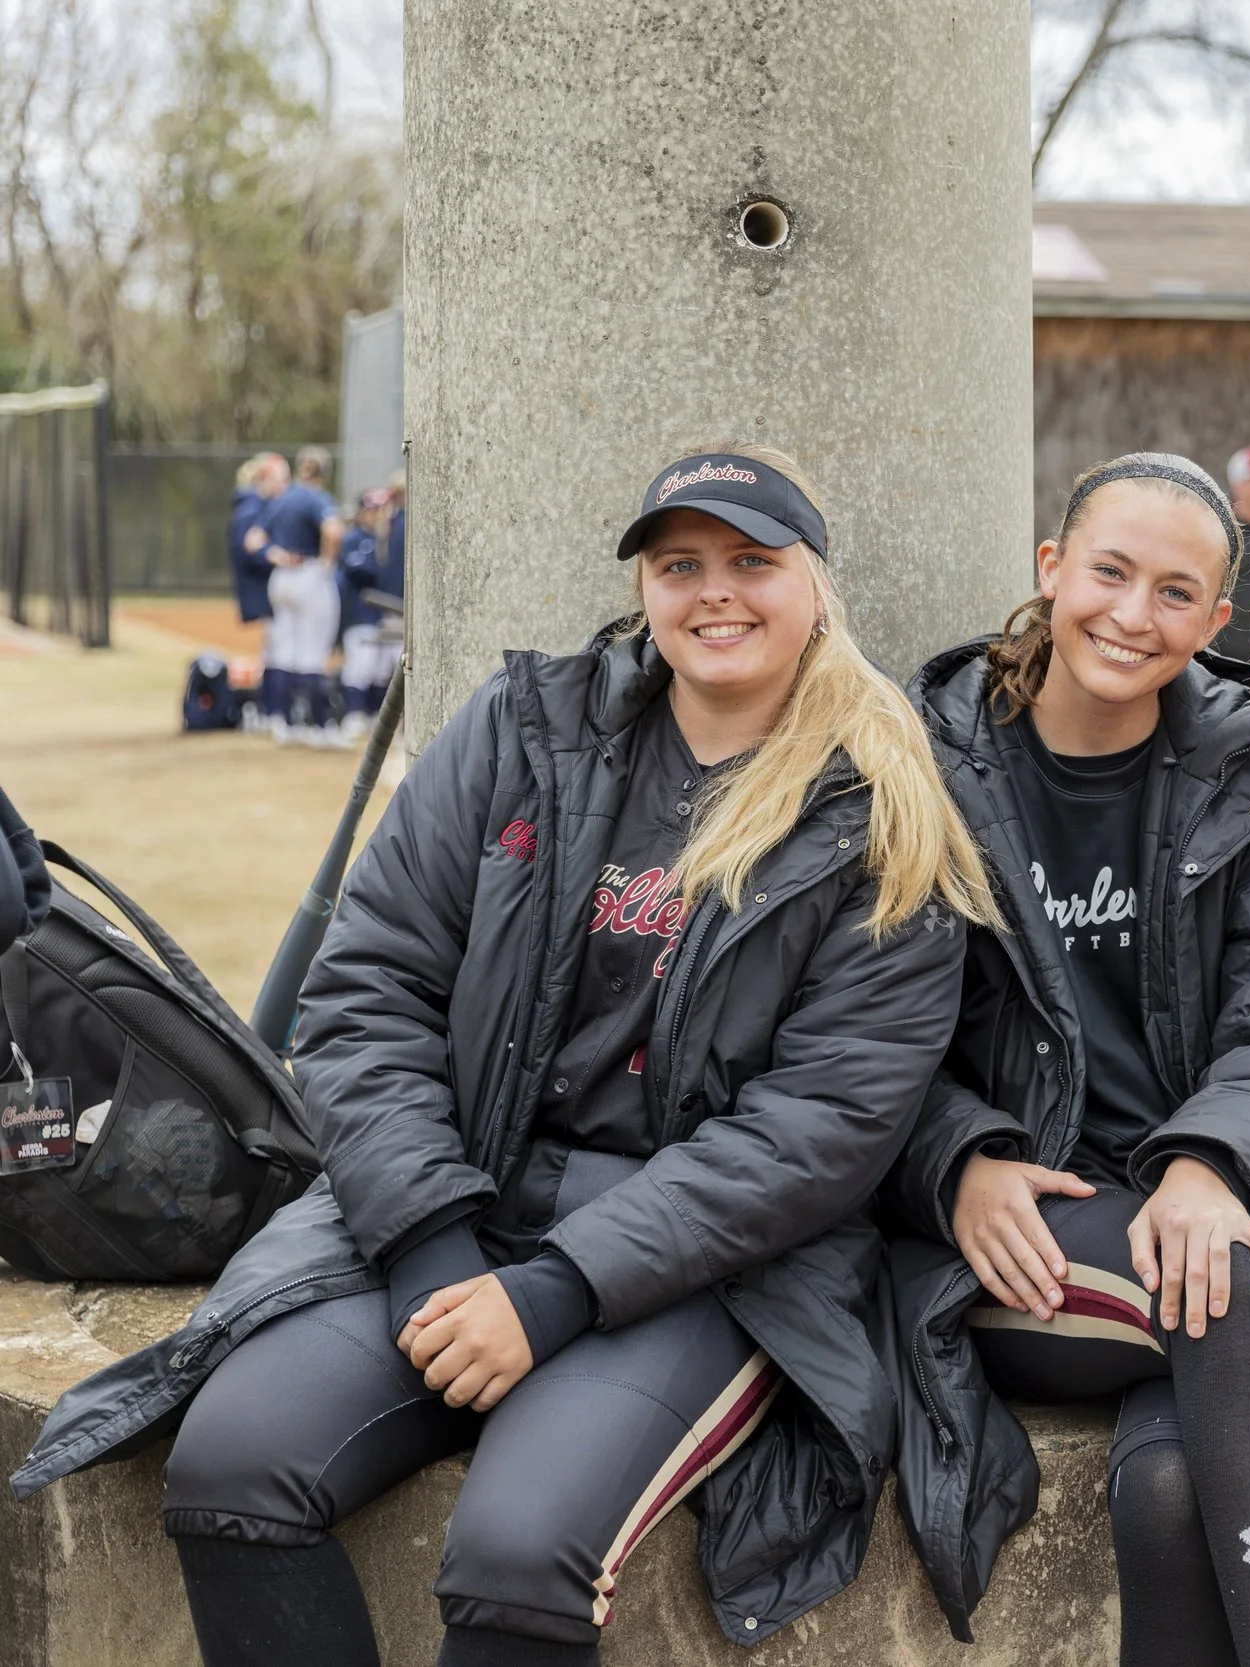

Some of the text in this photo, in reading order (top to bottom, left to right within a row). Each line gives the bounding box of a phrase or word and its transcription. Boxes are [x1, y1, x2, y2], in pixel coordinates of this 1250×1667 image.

[656, 461, 757, 504] Charleston
[597, 863, 630, 888] The
[42, 1123, 71, 1139] #25
